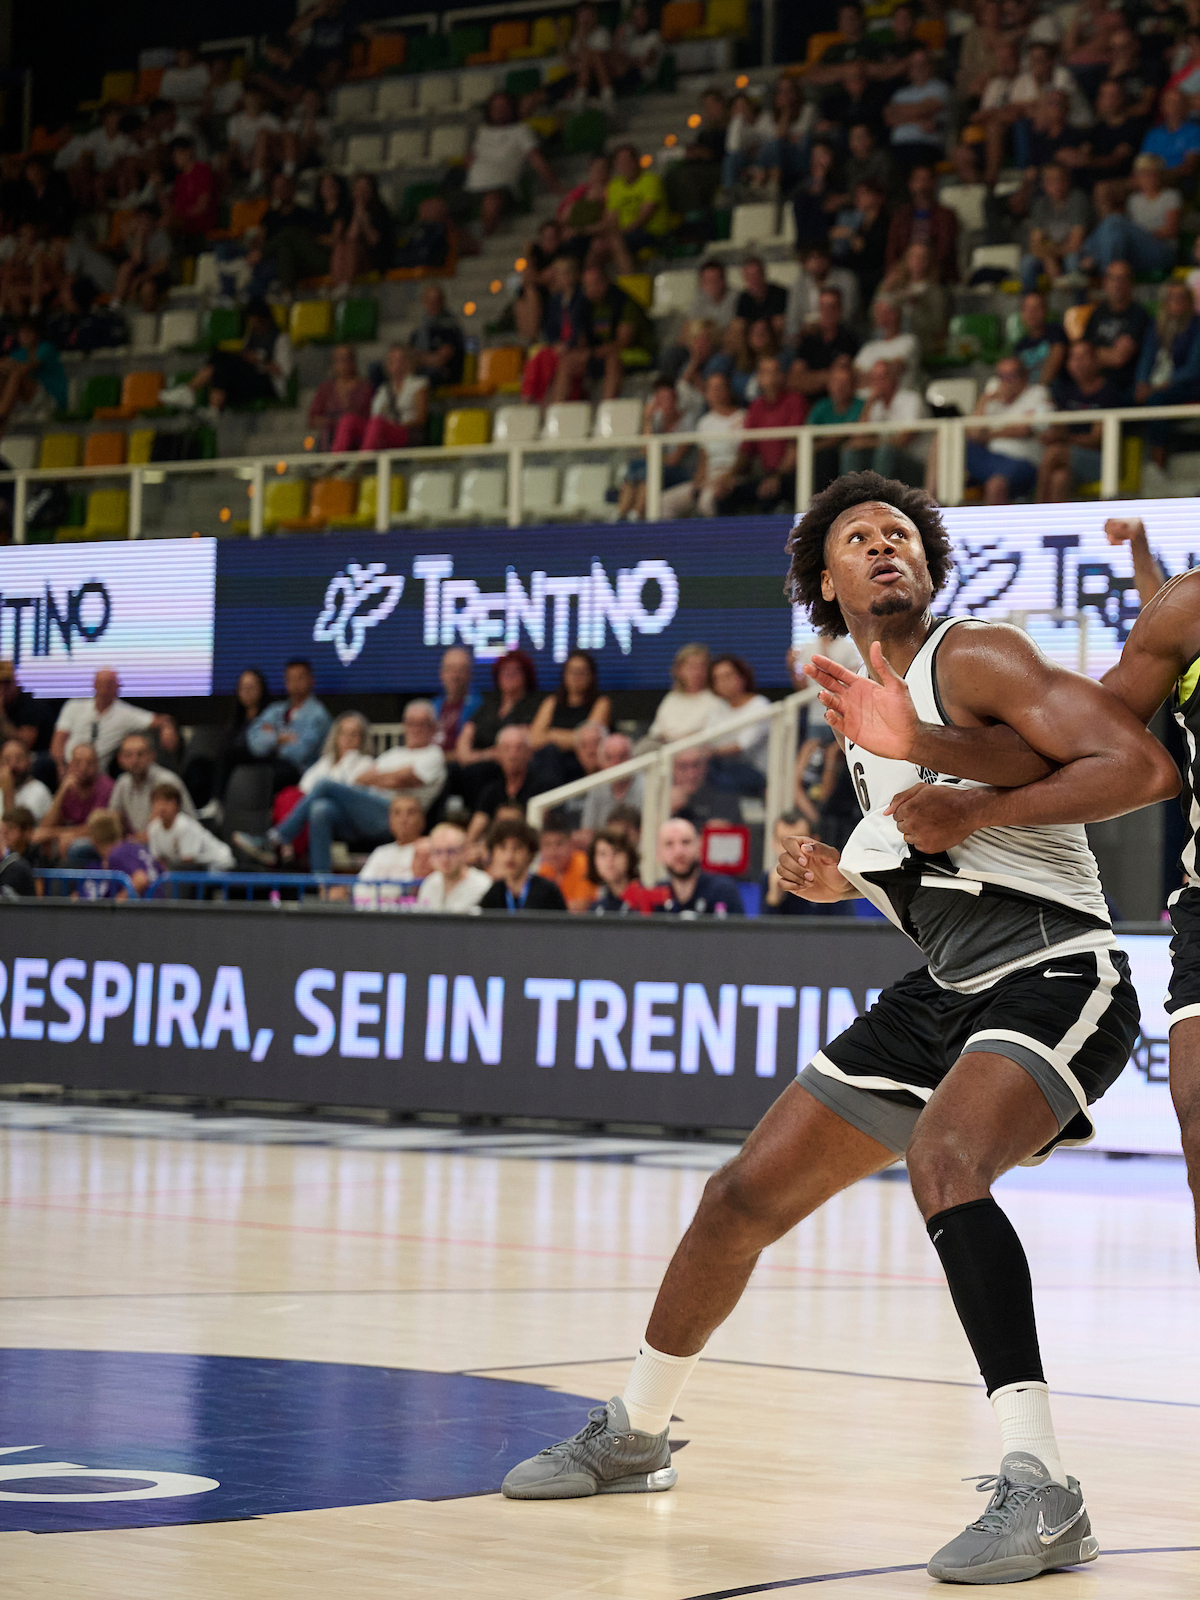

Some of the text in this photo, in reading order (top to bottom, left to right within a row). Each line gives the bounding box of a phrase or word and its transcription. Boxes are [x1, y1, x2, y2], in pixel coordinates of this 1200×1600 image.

[413, 554, 680, 663] TRENTINO
[0, 957, 274, 1062] ESPIRA,
[293, 967, 407, 1060] SEI
[424, 973, 505, 1066] IN
